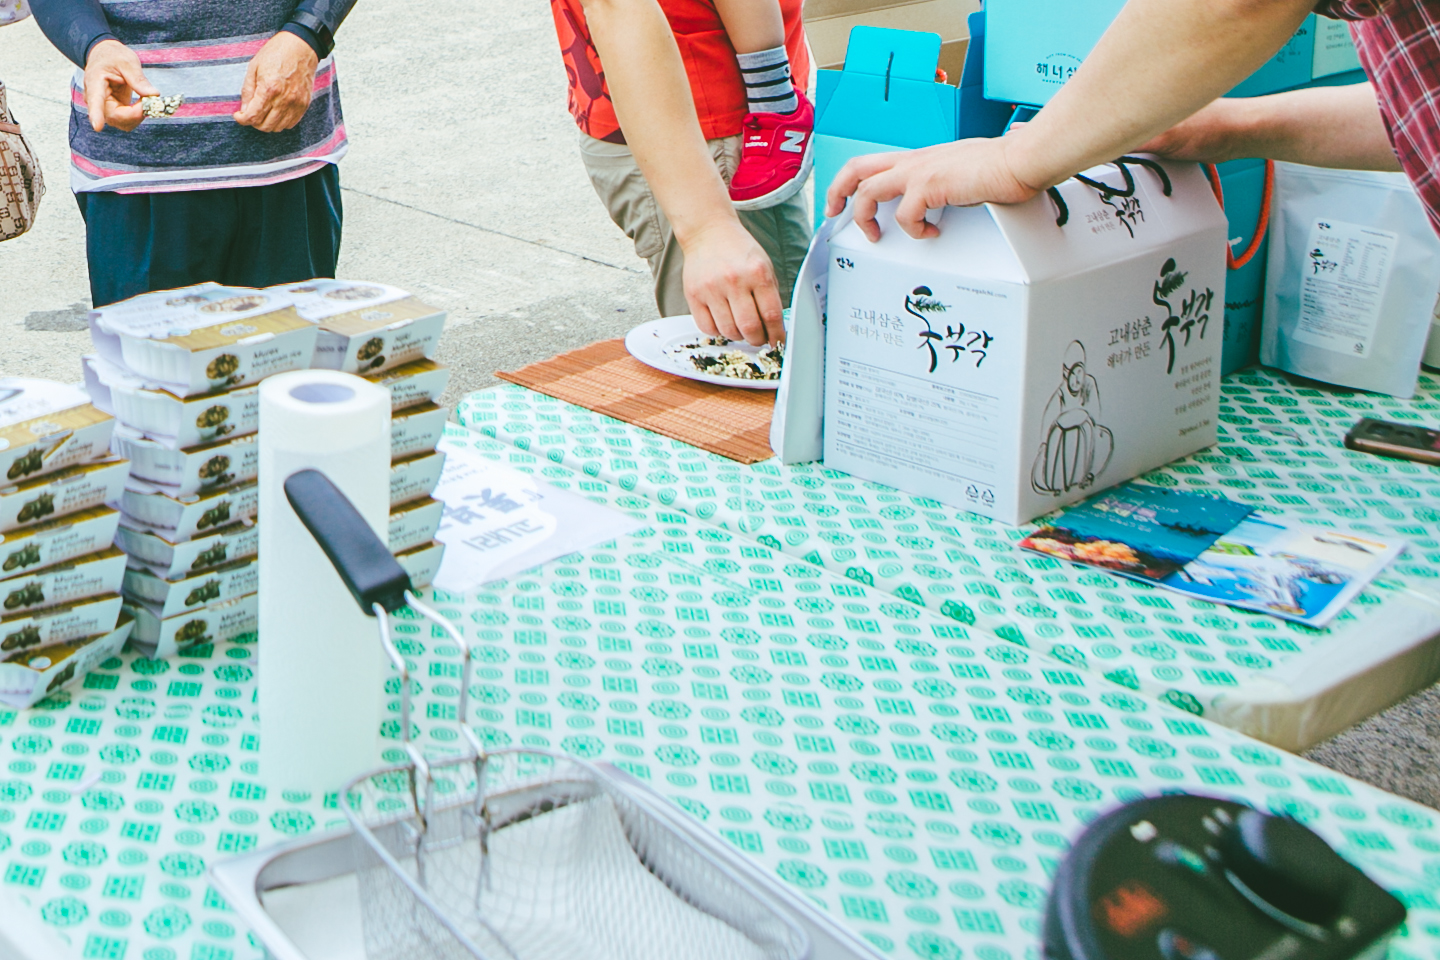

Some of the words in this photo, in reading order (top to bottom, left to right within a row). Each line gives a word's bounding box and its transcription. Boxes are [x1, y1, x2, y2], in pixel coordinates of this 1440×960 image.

[849, 306, 905, 333] 고내삼춘
[1107, 315, 1152, 347] 고내삼춘
[848, 324, 881, 342] 해녀가
[883, 331, 904, 348] 만든
[1134, 340, 1151, 360] 만든
